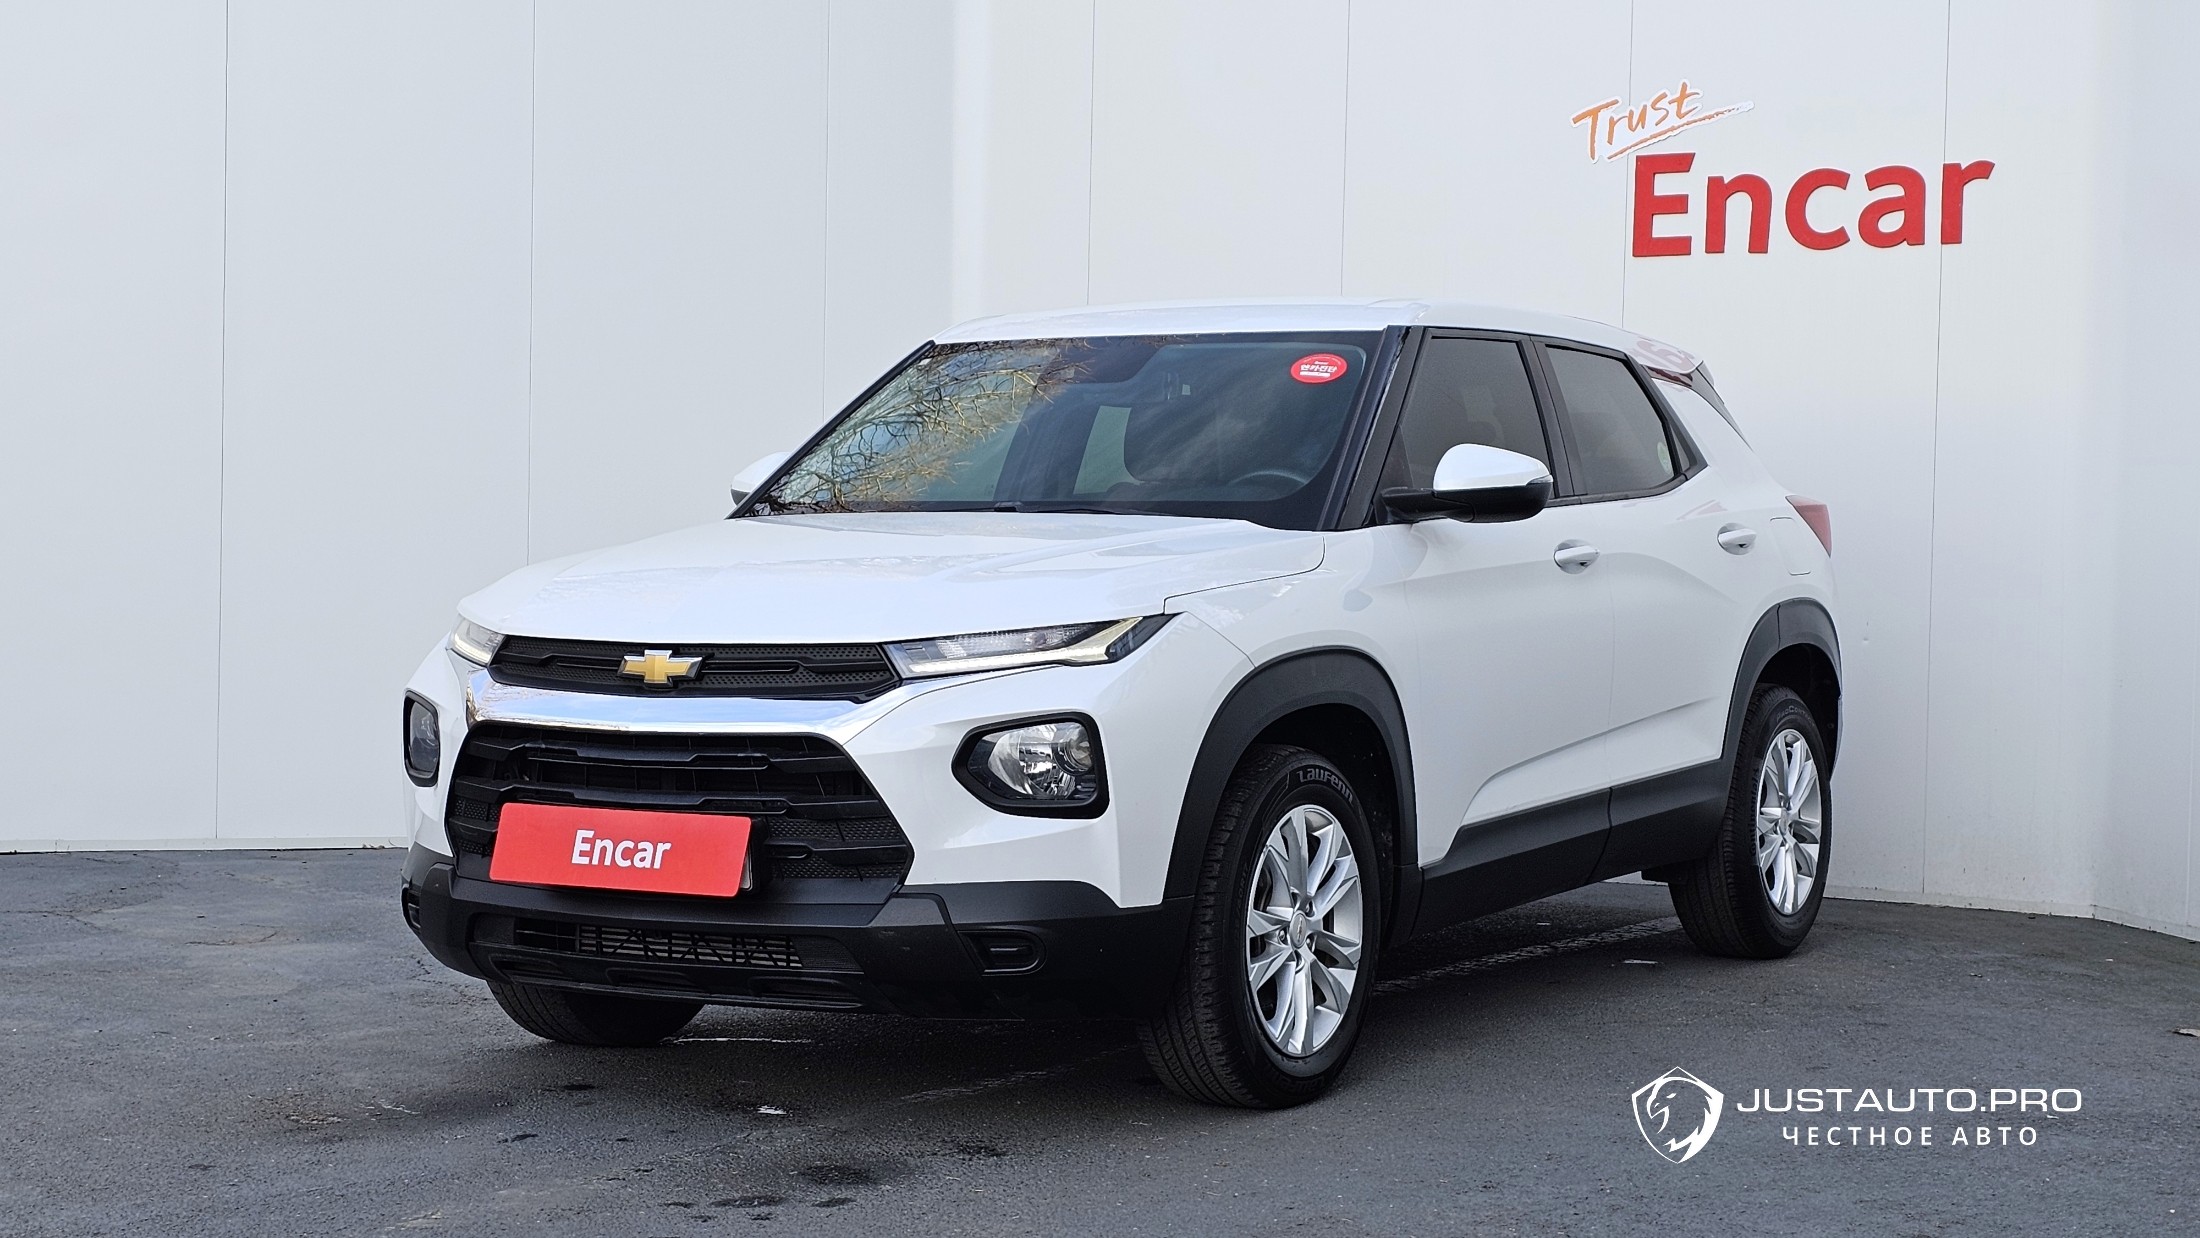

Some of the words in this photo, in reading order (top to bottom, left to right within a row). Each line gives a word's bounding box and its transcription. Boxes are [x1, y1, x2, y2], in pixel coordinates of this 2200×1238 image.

[1572, 82, 1703, 160] Trust
[1632, 152, 1995, 258] Encar
[571, 829, 672, 869] Encar
